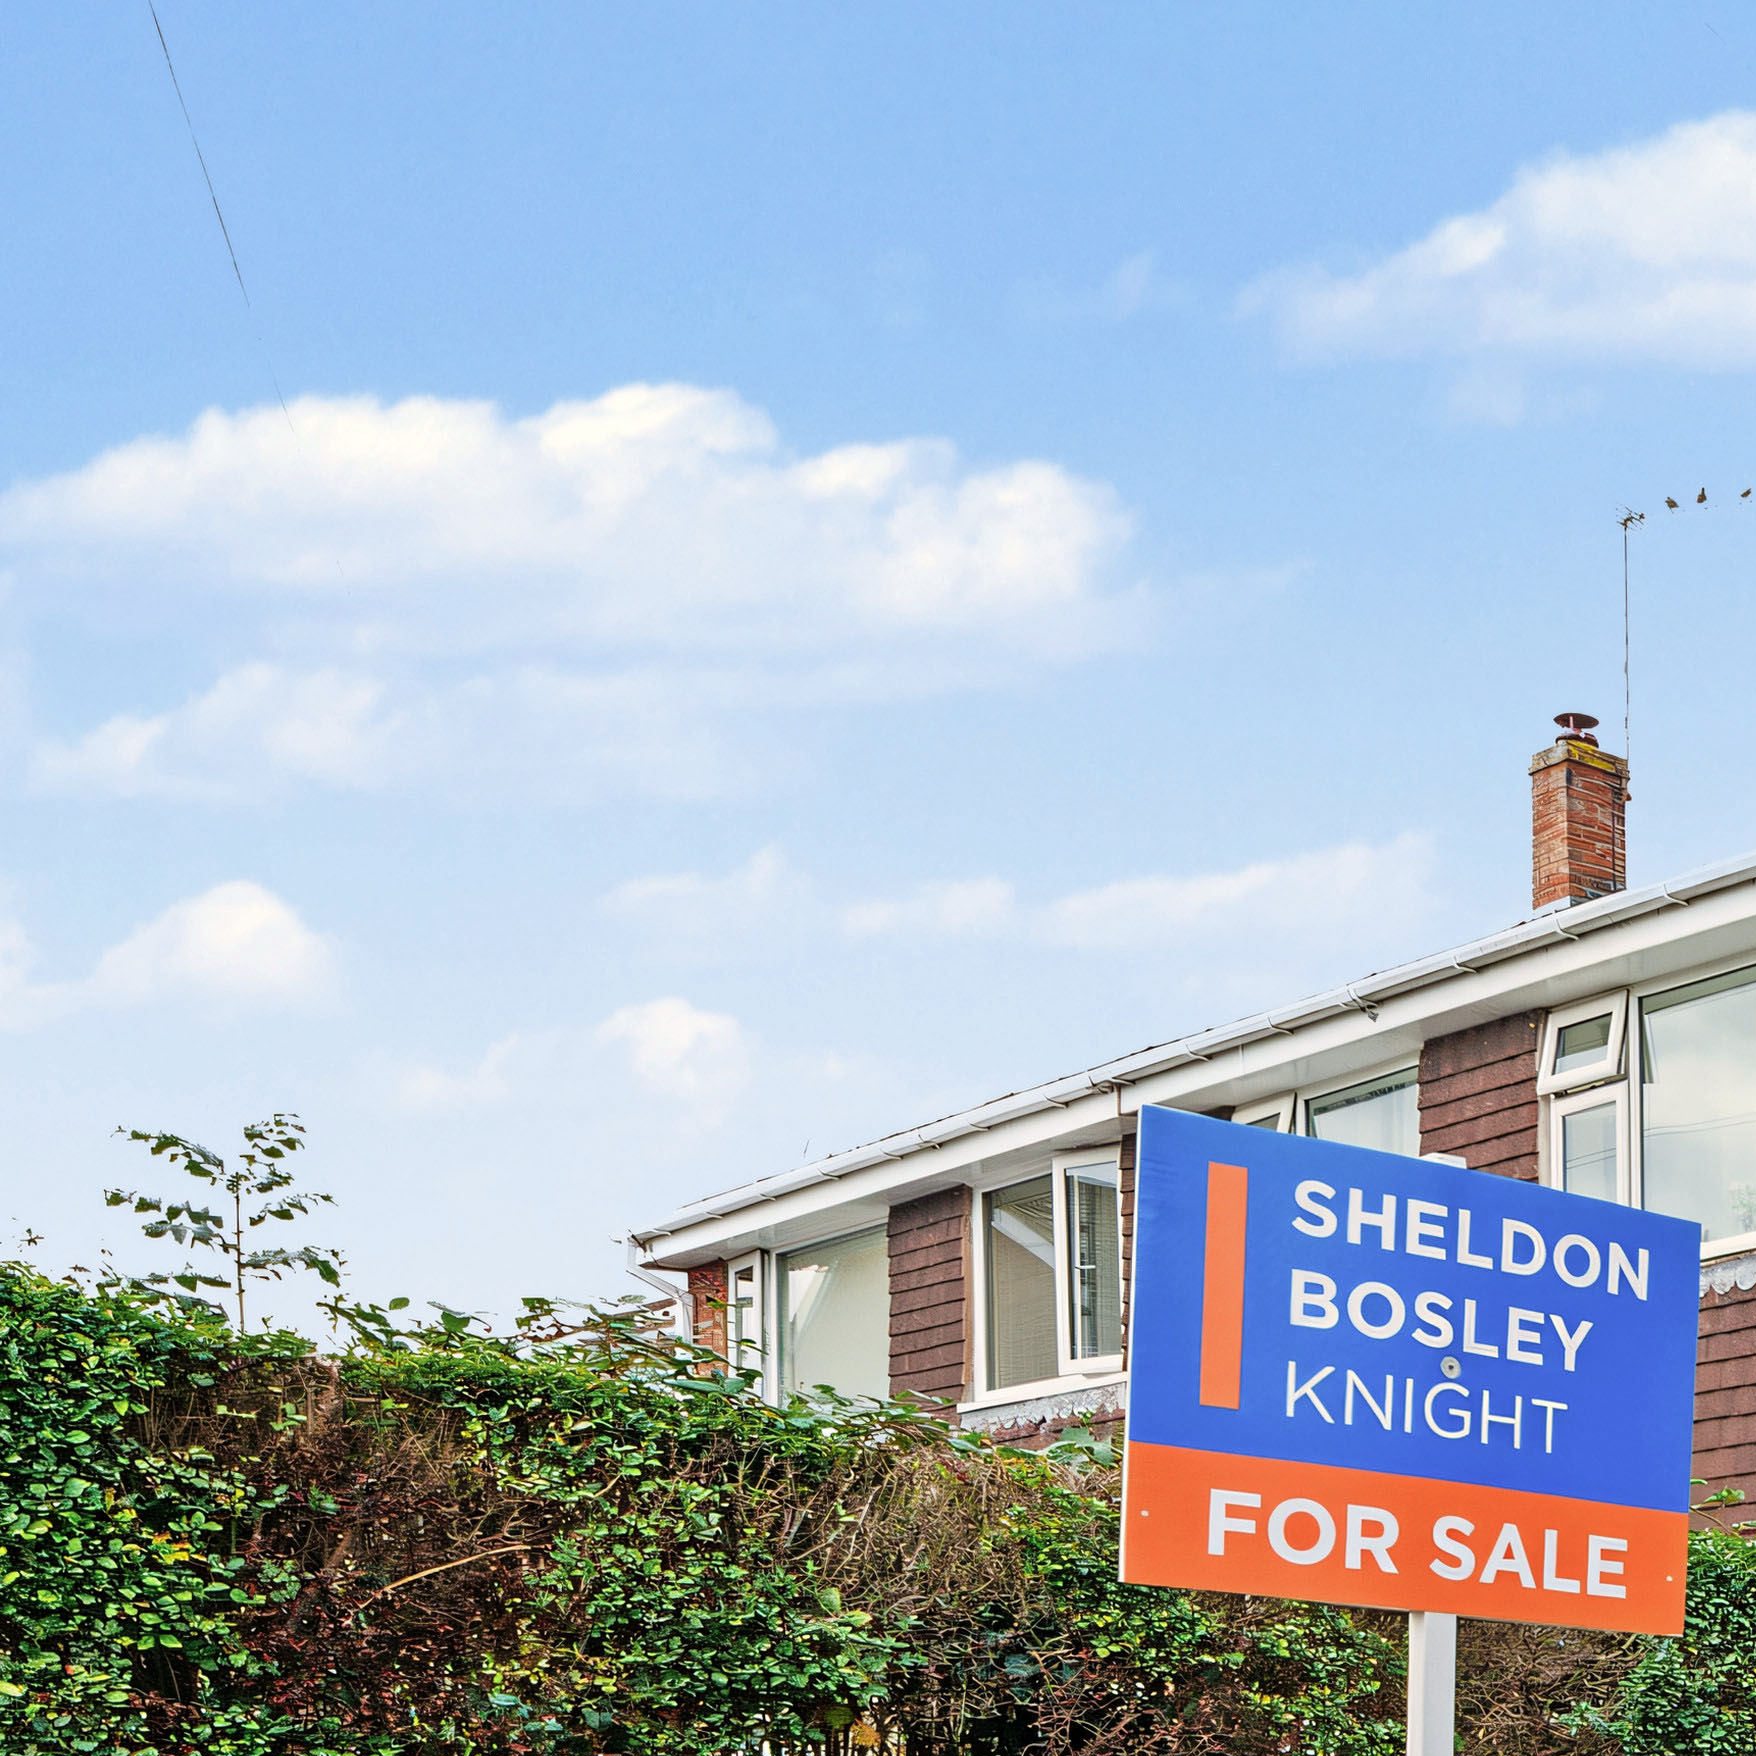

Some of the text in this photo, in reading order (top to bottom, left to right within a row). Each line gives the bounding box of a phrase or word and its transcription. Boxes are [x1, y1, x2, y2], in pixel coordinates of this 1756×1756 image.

[1291, 1179, 1649, 1301] SHELDON
[1289, 1268, 1594, 1372] BOSLEY
[1286, 1360, 1568, 1454] KNIGHT
[1207, 1487, 1628, 1599] FOR SALE
